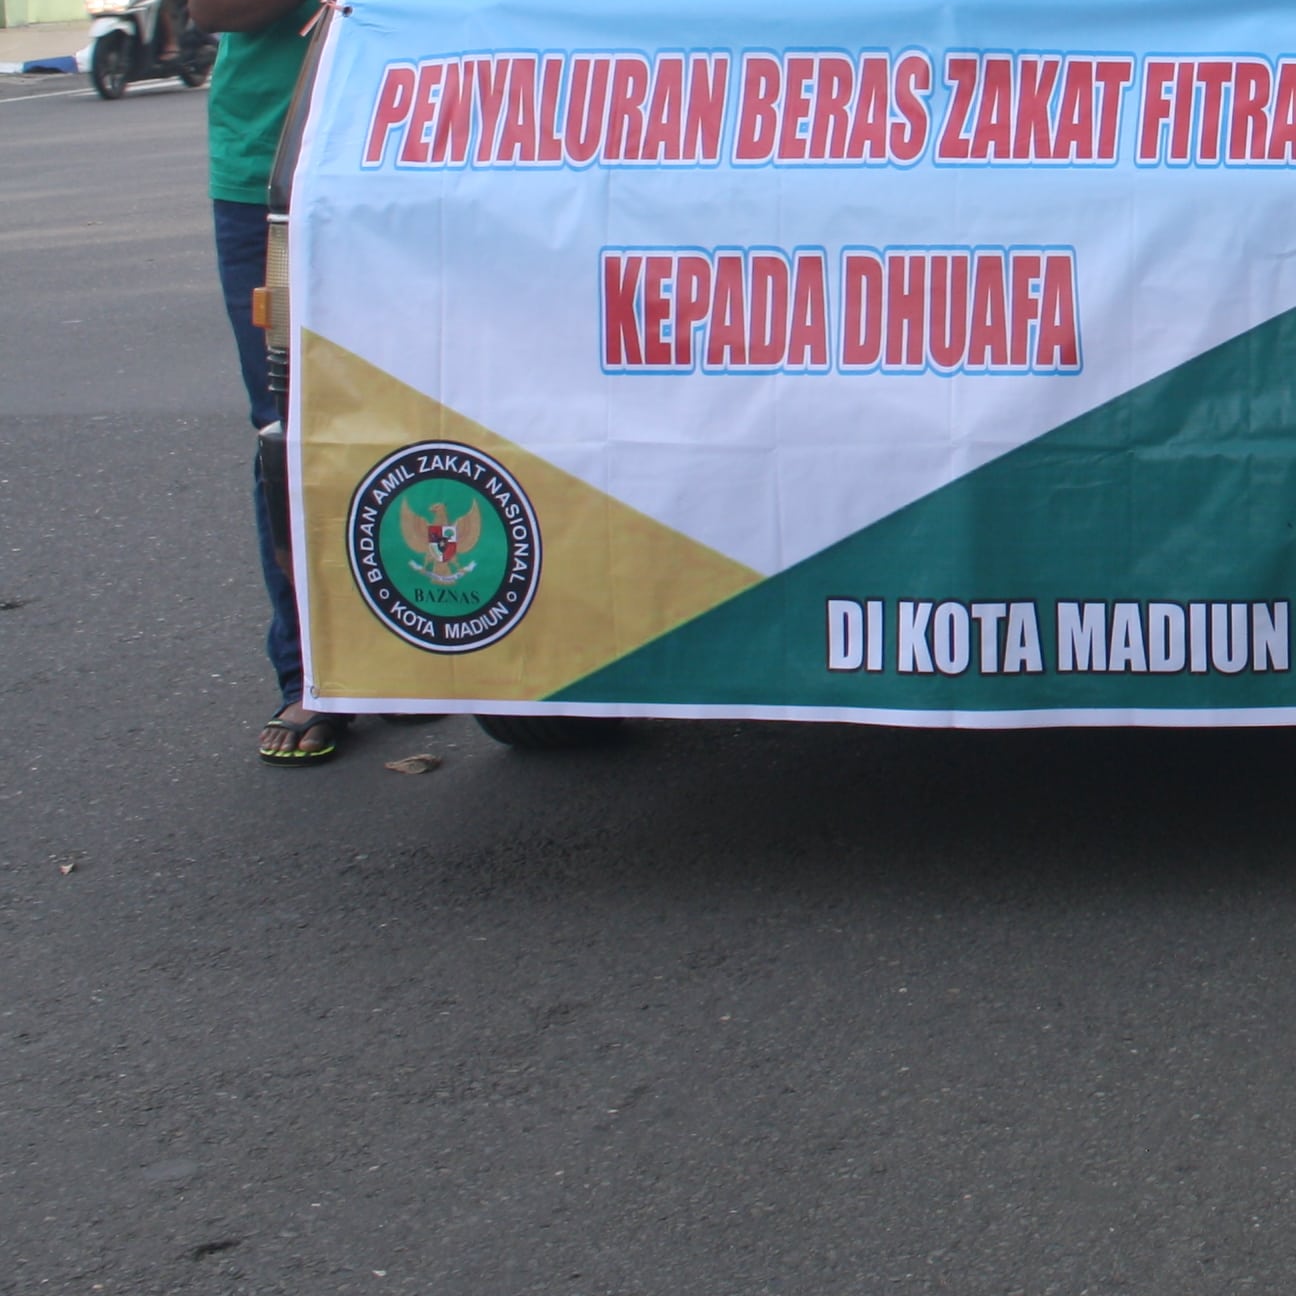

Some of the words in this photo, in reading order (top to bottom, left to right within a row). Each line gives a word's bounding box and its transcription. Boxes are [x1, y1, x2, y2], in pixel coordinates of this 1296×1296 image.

[362, 57, 729, 165] PENYALURAN
[734, 53, 933, 161] BERAS
[939, 58, 1132, 161] ZAKAT
[604, 255, 828, 367] KEPADA
[839, 255, 1080, 369] DHUAFA
[360, 506, 383, 583] BADAN
[372, 465, 415, 505] AMIL
[417, 455, 486, 481] ZAKAT
[486, 476, 529, 584] NASIONAL
[390, 601, 435, 638] KOTA
[444, 601, 510, 640] MADIUN
[414, 588, 481, 604] BAZNAS
[827, 599, 883, 671] DI
[898, 600, 1044, 675] KOTA
[1057, 601, 1291, 675] MADIUN
